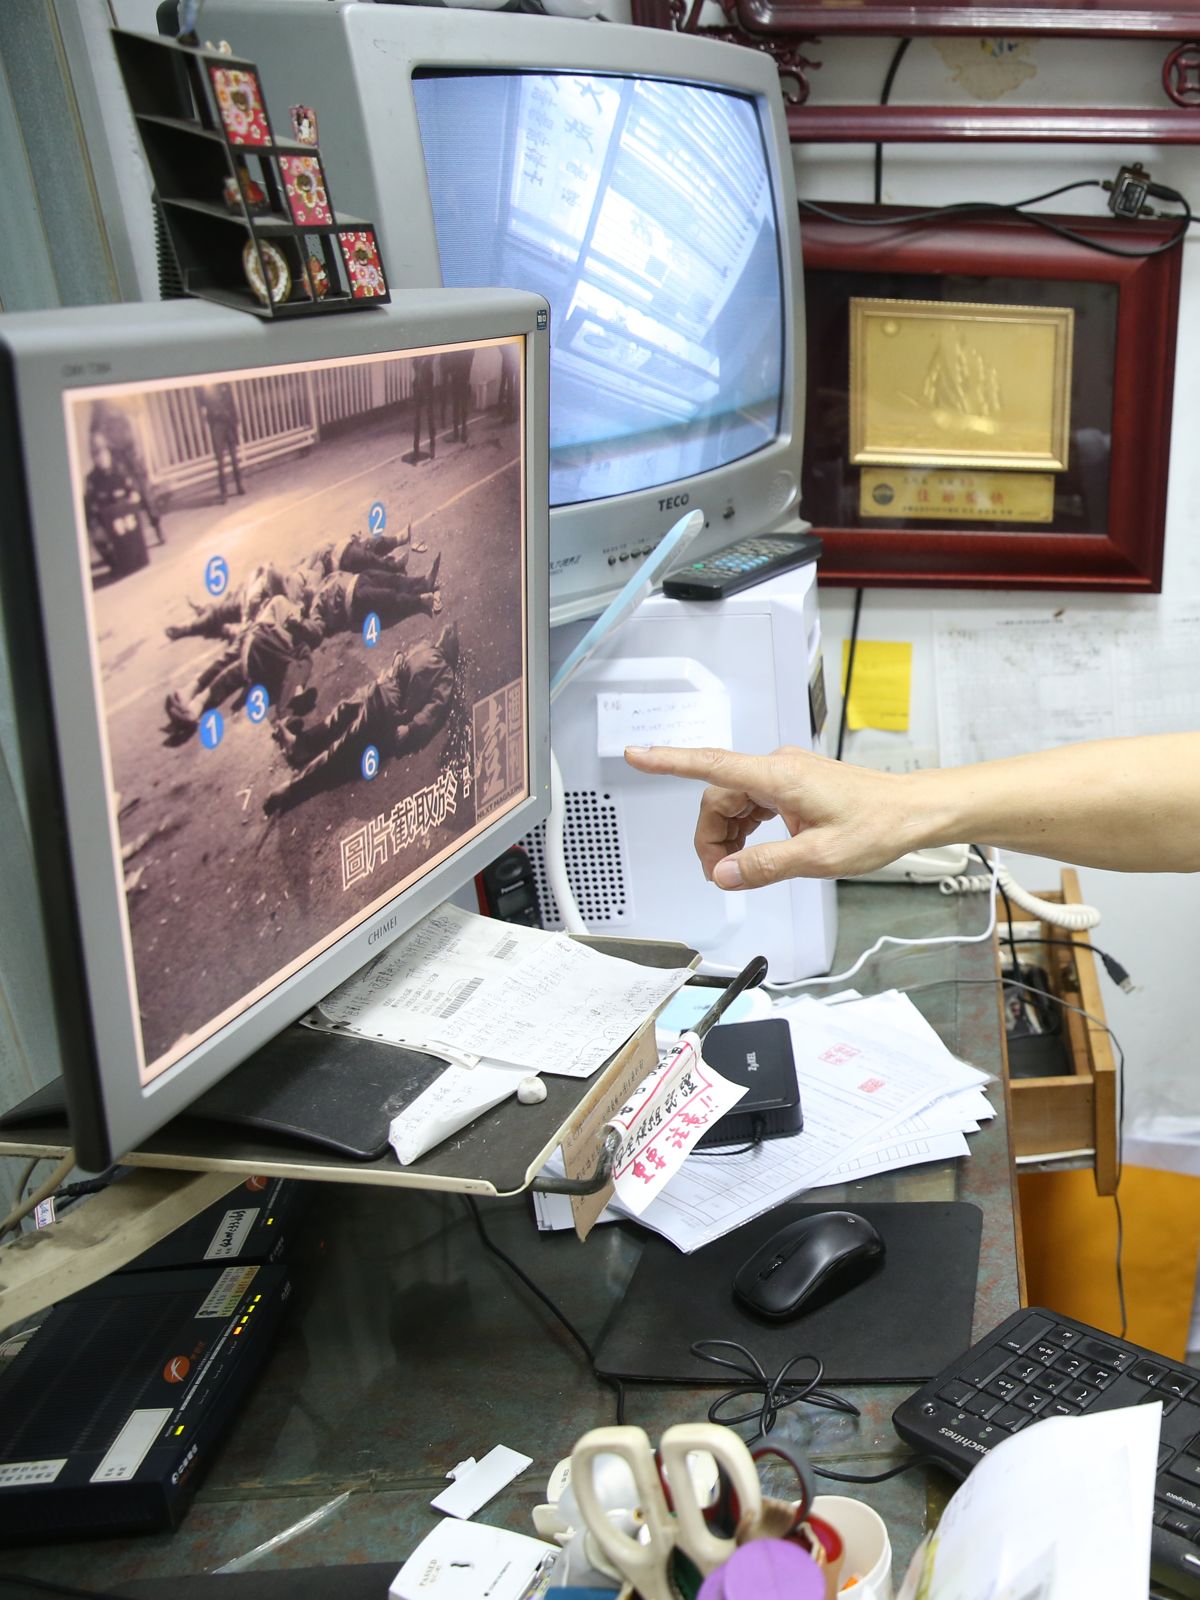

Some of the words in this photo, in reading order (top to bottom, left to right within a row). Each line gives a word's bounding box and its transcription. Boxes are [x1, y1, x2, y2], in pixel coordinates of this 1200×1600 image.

[658, 493, 690, 511] TECO
[367, 916, 399, 946] CHIMEI
[746, 1051, 757, 1072] ZyXEL
[632, 1147, 667, 1184] 重要
